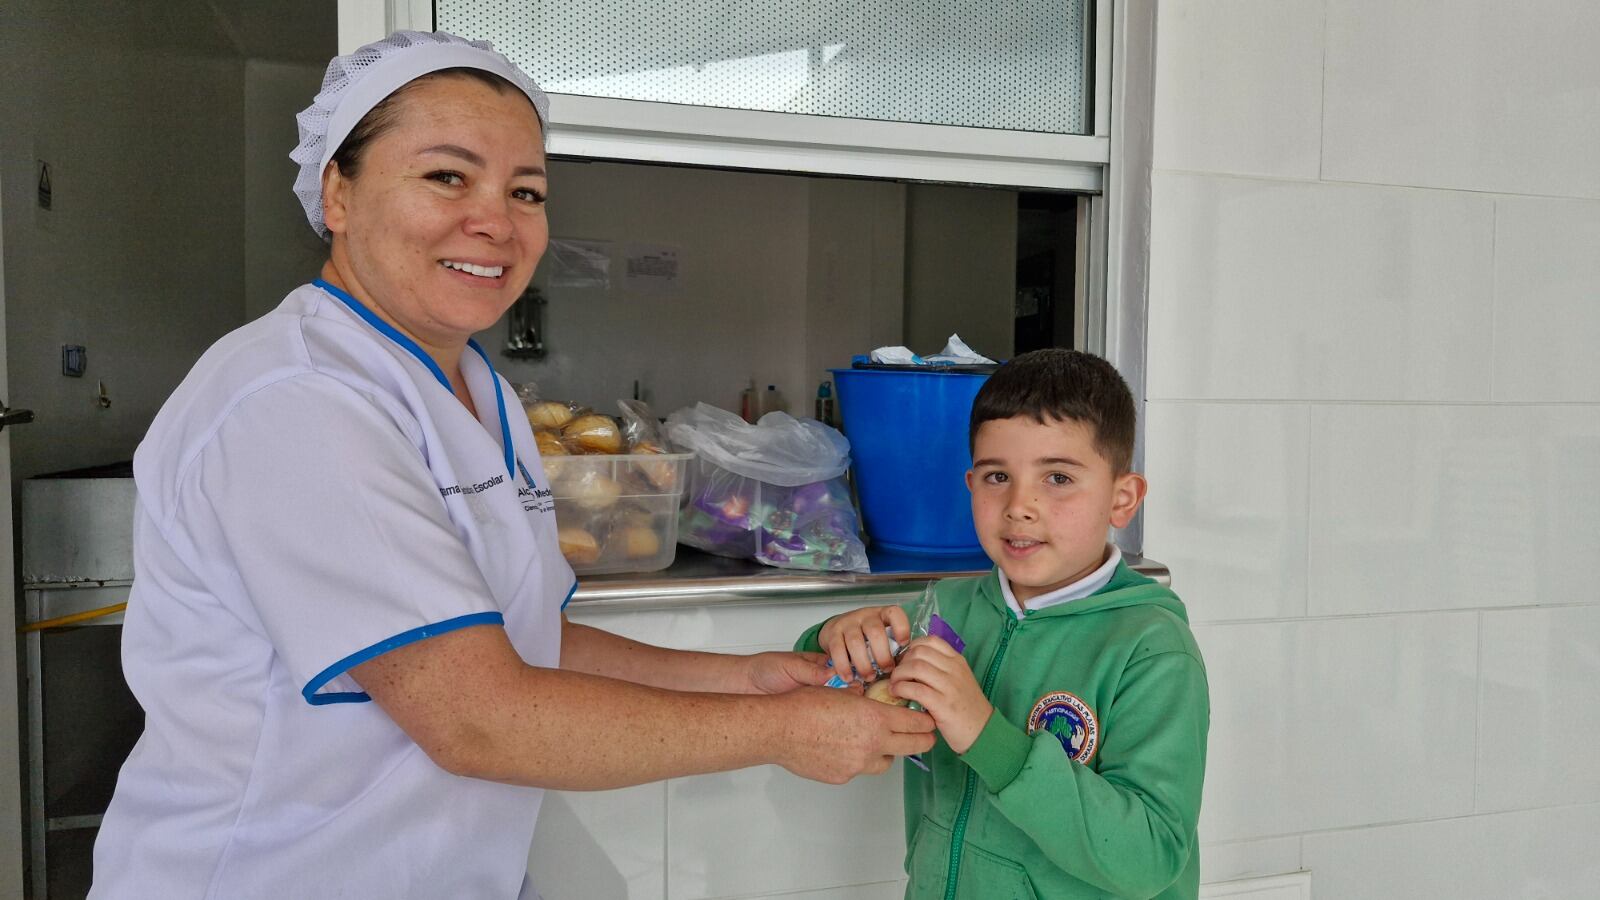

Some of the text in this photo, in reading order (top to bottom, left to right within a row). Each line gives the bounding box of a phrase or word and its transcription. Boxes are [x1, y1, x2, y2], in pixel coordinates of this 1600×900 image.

[473, 475, 504, 494] Escolar
[1030, 704, 1042, 726] CENTRO
[1073, 701, 1083, 712] LAS
[1083, 711, 1096, 735] PLAYAS
